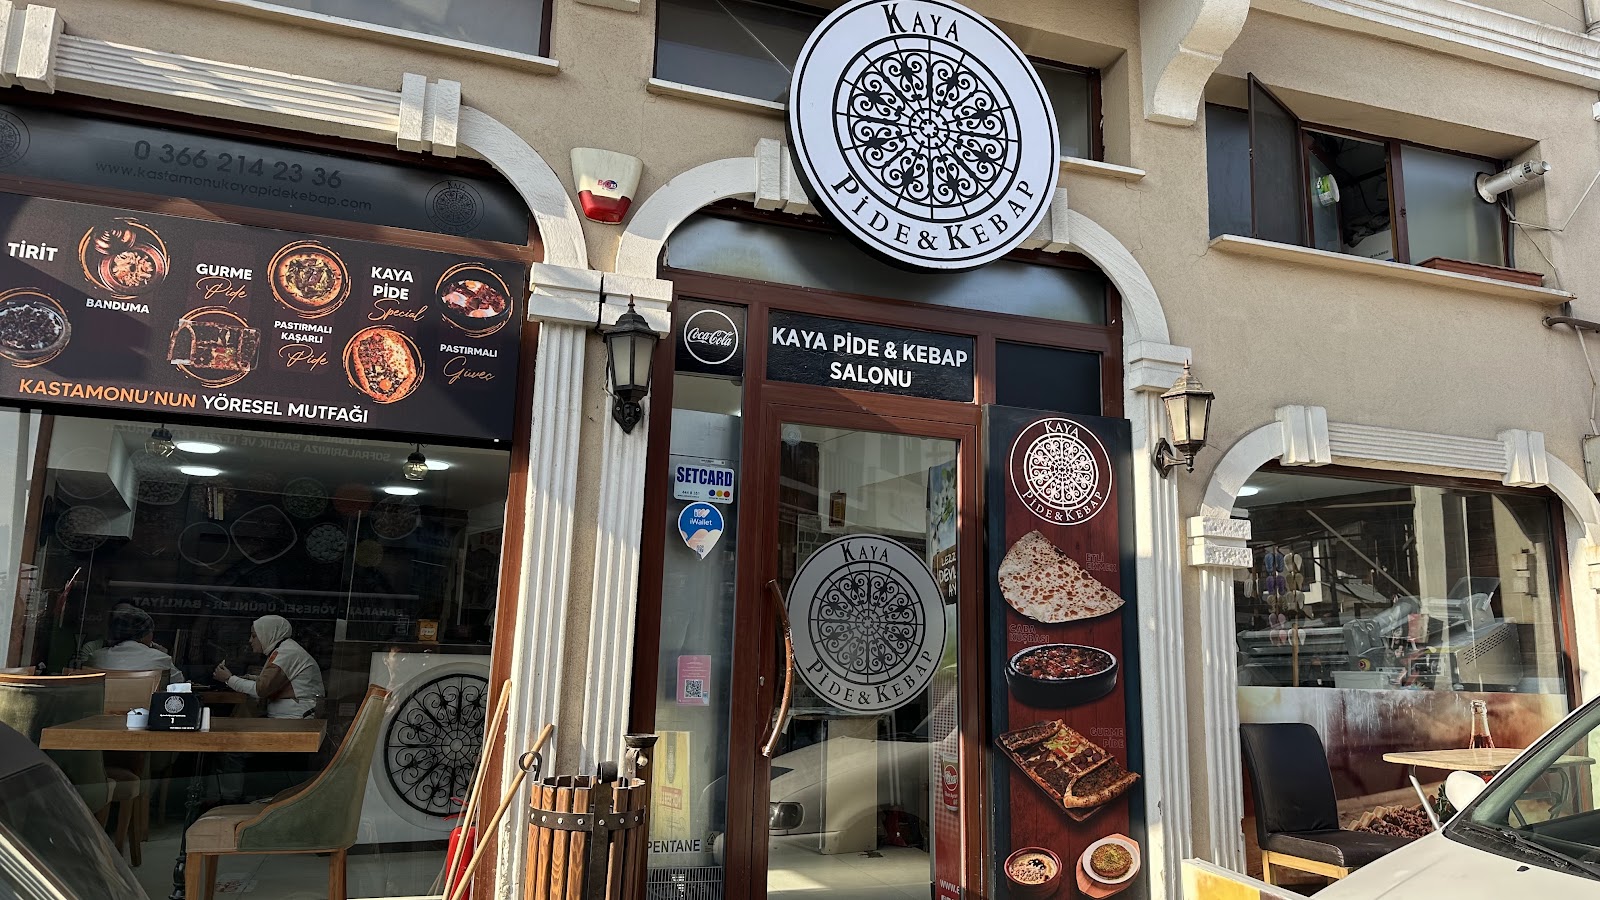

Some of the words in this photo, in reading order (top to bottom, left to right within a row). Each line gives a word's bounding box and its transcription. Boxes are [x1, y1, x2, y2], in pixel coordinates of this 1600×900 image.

[881, 3, 959, 42] KAYA
[134, 140, 151, 161] 0
[159, 143, 208, 169] 366
[217, 152, 264, 177] 214
[273, 161, 303, 183] 23
[312, 167, 342, 189] 36
[95, 161, 372, 211] www.kastamonukayapidekebap.com
[7, 240, 58, 262] TİRİT
[196, 263, 253, 281] GURME
[371, 266, 414, 283] KAYA
[195, 276, 248, 304] Pide
[372, 282, 409, 300] PİDE
[86, 298, 150, 314] BANDUMA
[367, 298, 428, 321] Special
[273, 320, 333, 334] PASTIRMALI
[281, 331, 324, 344] KAŞARLI
[772, 326, 828, 351] KAYA
[833, 331, 880, 358] PİDE
[884, 340, 898, 359] &
[902, 343, 969, 368] KEBAP
[278, 343, 329, 371] Pide
[440, 343, 498, 358] PASTIRMALI
[829, 361, 912, 388] SALONU
[202, 393, 283, 417] YÖRESEL
[287, 404, 369, 424] MUTFAĞI
[1043, 420, 1080, 439] KAYA
[676, 466, 733, 487] SETCARD
[689, 518, 713, 527] iWallet
[840, 541, 889, 564] KAYA
[1090, 727, 1125, 738] GURME
[1102, 736, 1125, 749] PİDE
[648, 839, 701, 853] PENTANE
